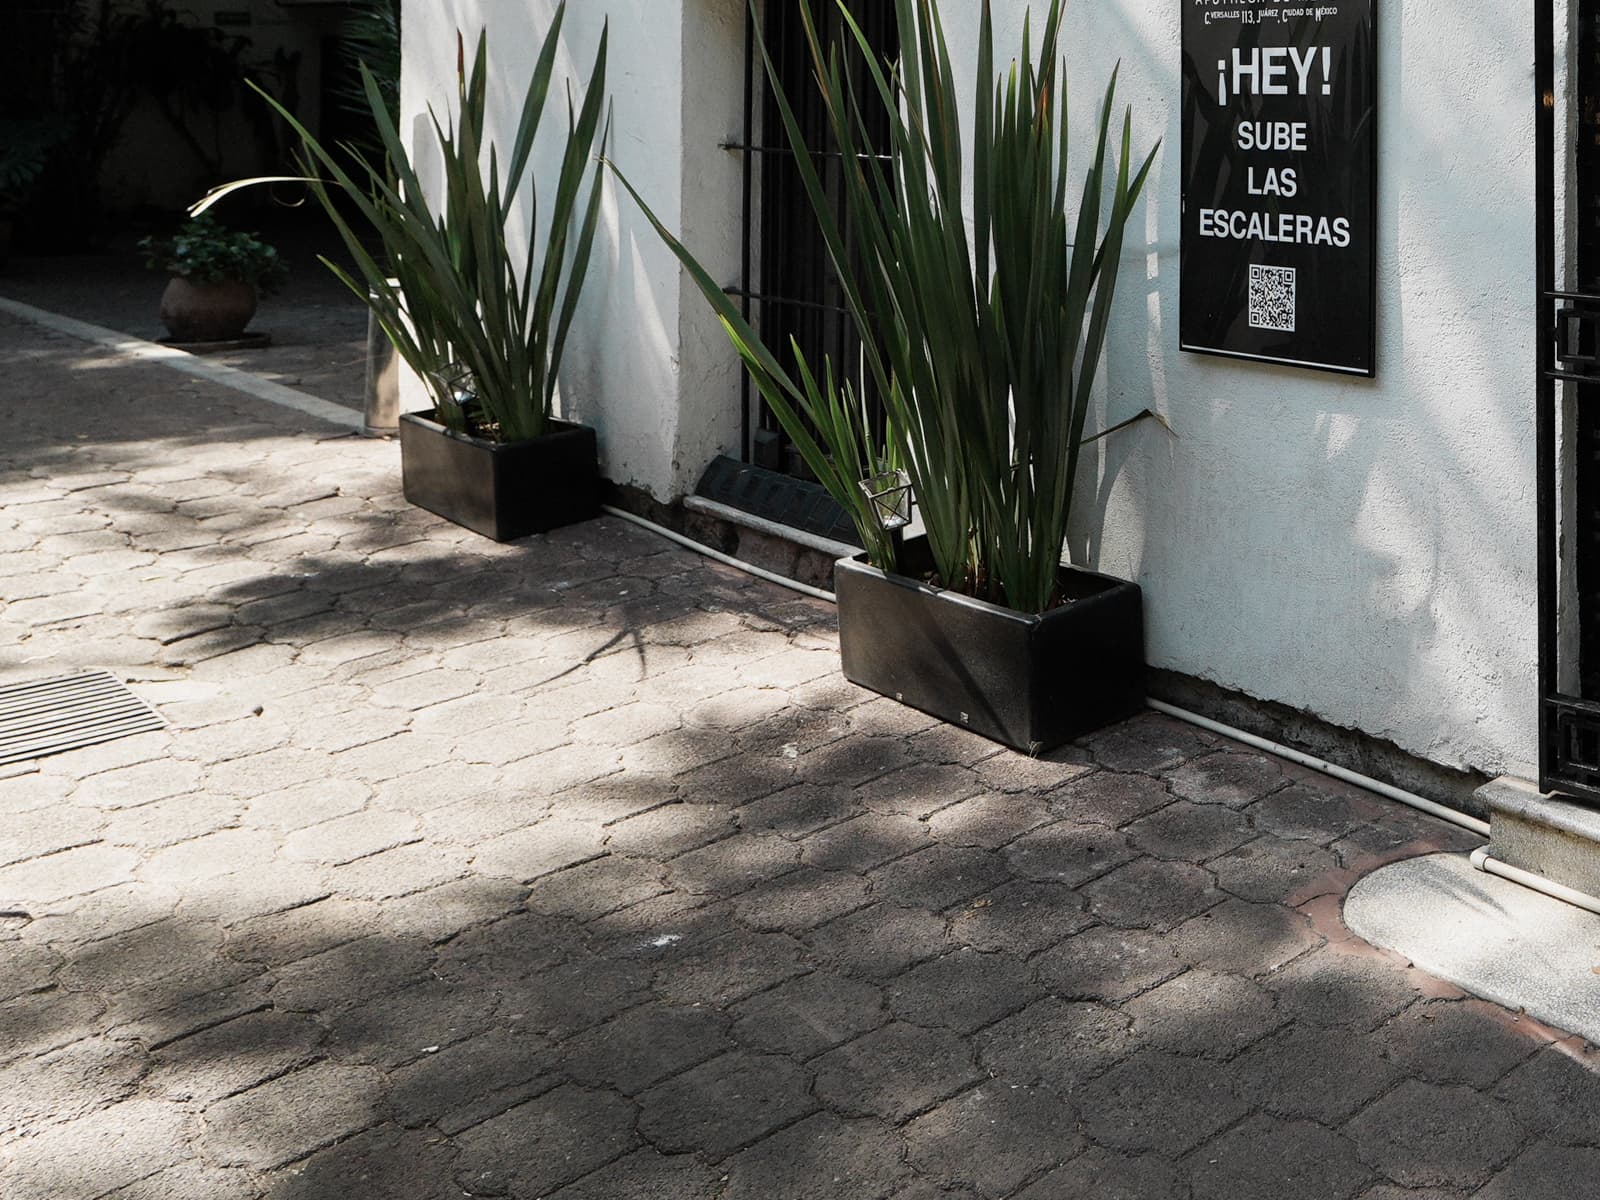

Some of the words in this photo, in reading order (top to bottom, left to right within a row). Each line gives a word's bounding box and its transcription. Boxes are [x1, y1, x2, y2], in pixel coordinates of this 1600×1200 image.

[1282, 8, 1304, 22] CIUDAD
[1306, 8, 1313, 16] DE
[1315, 5, 1338, 22] MÉXICO
[1217, 46, 1332, 106] ¡HEY!
[1237, 121, 1307, 152] SUBE
[1247, 166, 1297, 198] LAS
[1199, 208, 1351, 248] ESCALERAS
